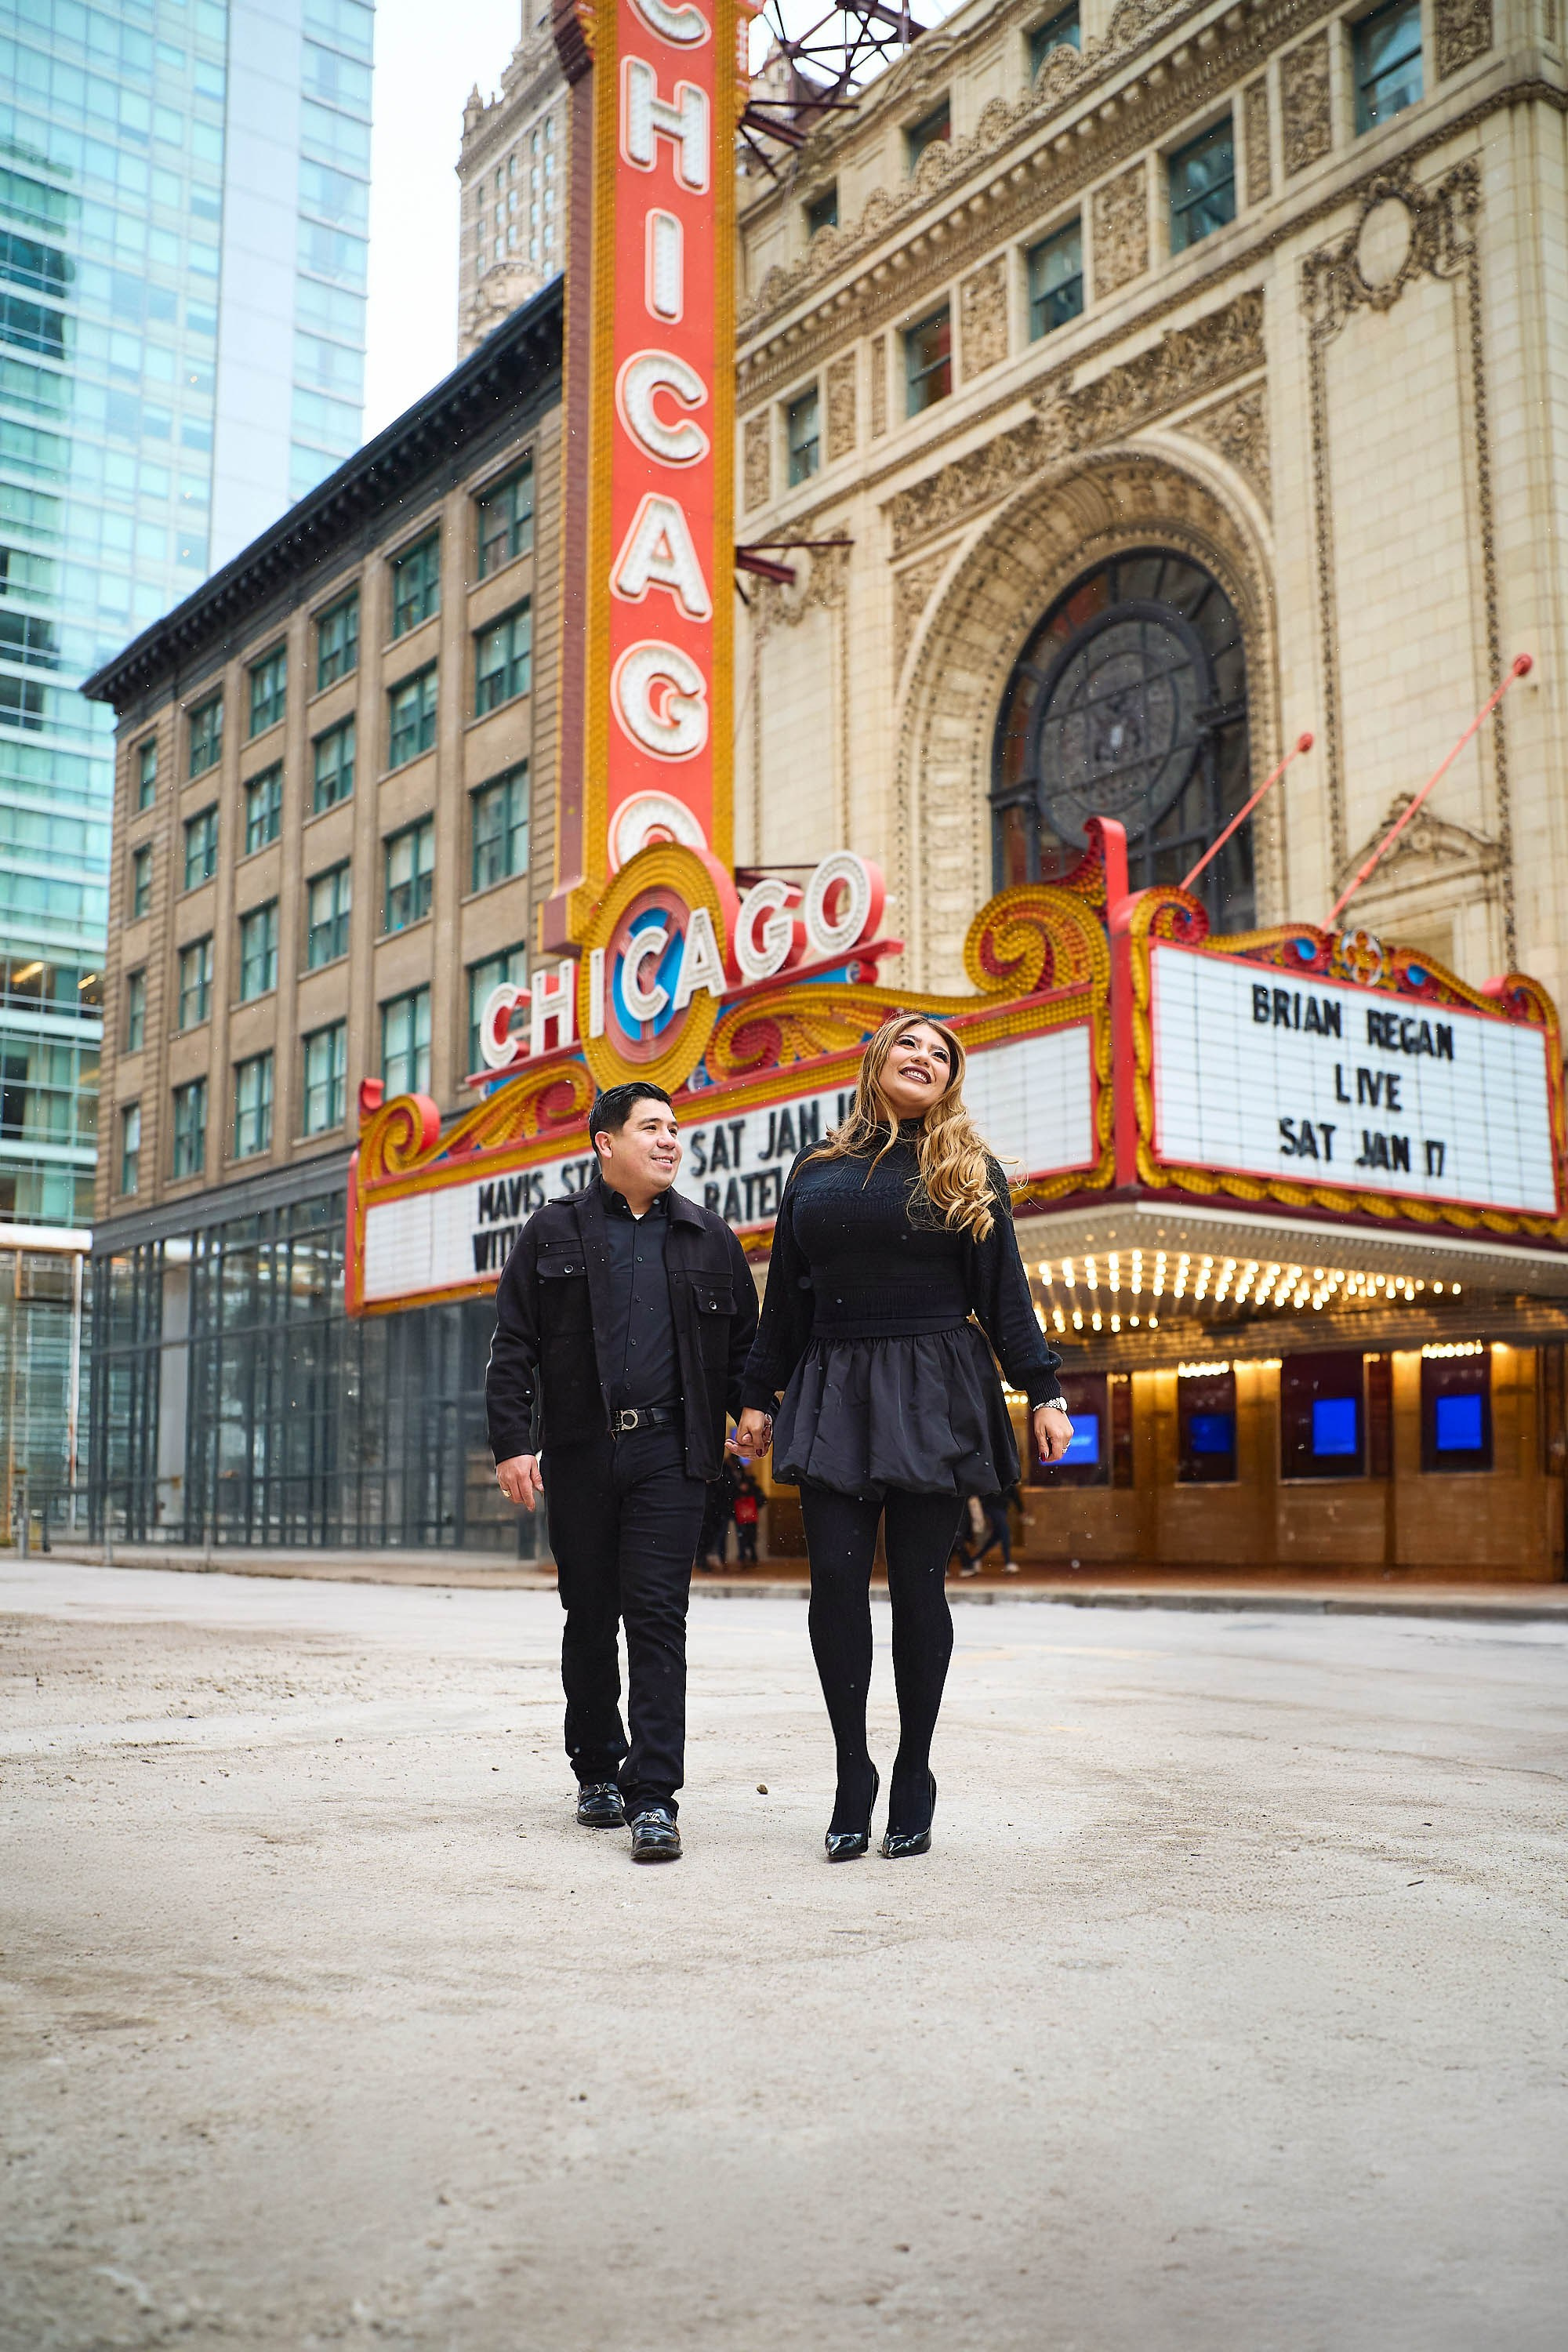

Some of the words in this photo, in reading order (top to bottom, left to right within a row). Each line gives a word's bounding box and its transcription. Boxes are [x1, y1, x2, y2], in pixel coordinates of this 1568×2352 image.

[480, 851, 872, 1069] CHICAGO
[1252, 983, 1341, 1039] BRIAN
[1367, 1008, 1454, 1062] REGAN
[1335, 1063, 1403, 1112] LIVE
[479, 1171, 545, 1225] MAVIS
[691, 1120, 746, 1177] SAT
[758, 1100, 820, 1161] JAN
[1279, 1117, 1337, 1162] SAT
[1356, 1130, 1410, 1173] JAN
[1425, 1140, 1445, 1178] 17
